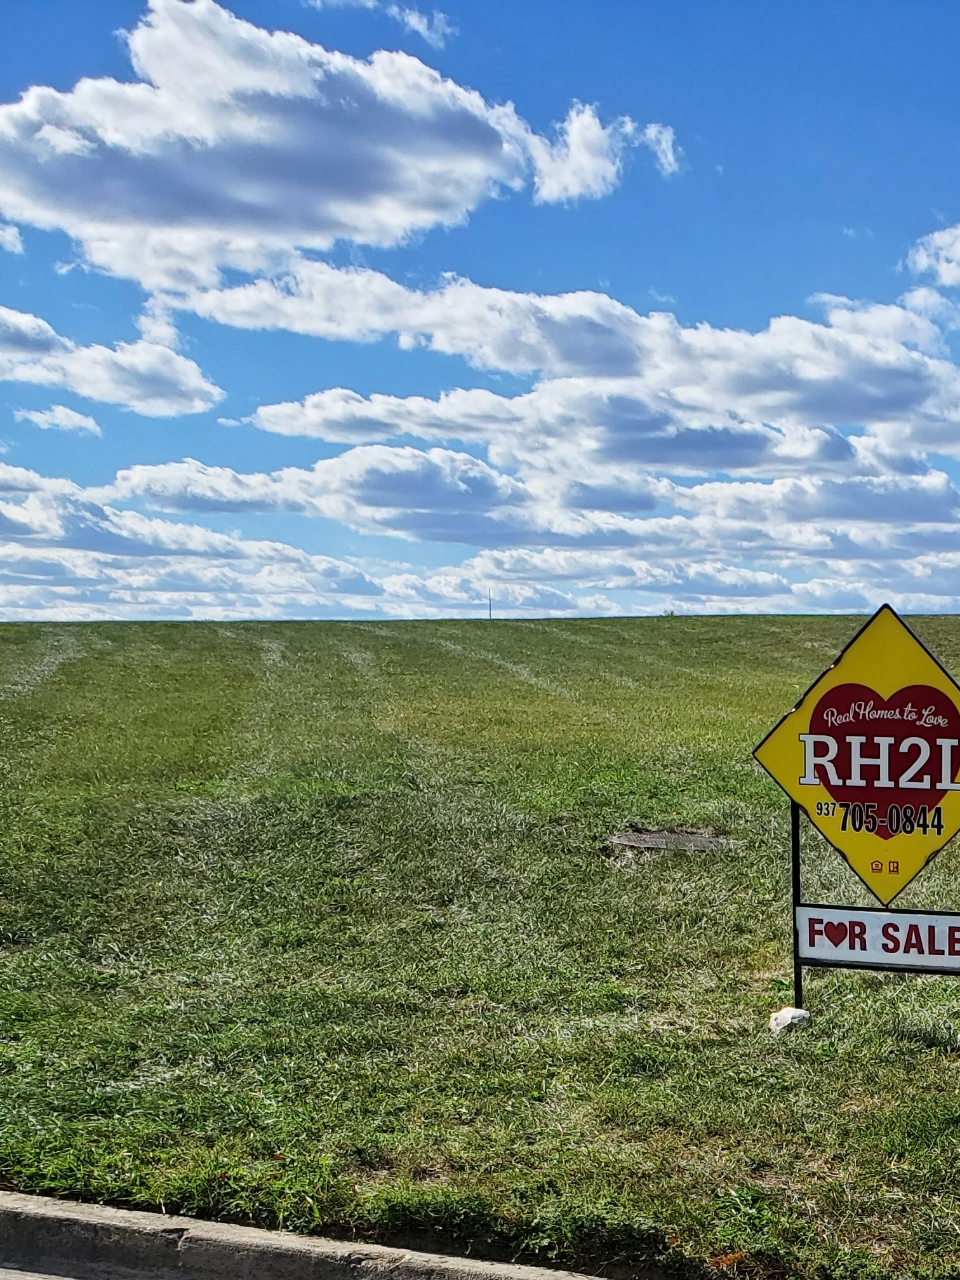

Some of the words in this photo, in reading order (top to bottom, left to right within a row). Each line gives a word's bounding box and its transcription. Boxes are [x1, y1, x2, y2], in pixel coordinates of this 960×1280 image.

[823, 702, 856, 728] Real
[855, 700, 902, 721] Homes
[903, 702, 918, 720] to
[915, 705, 949, 727] Love
[816, 801, 836, 817] 937
[838, 801, 944, 837] 705-0844
